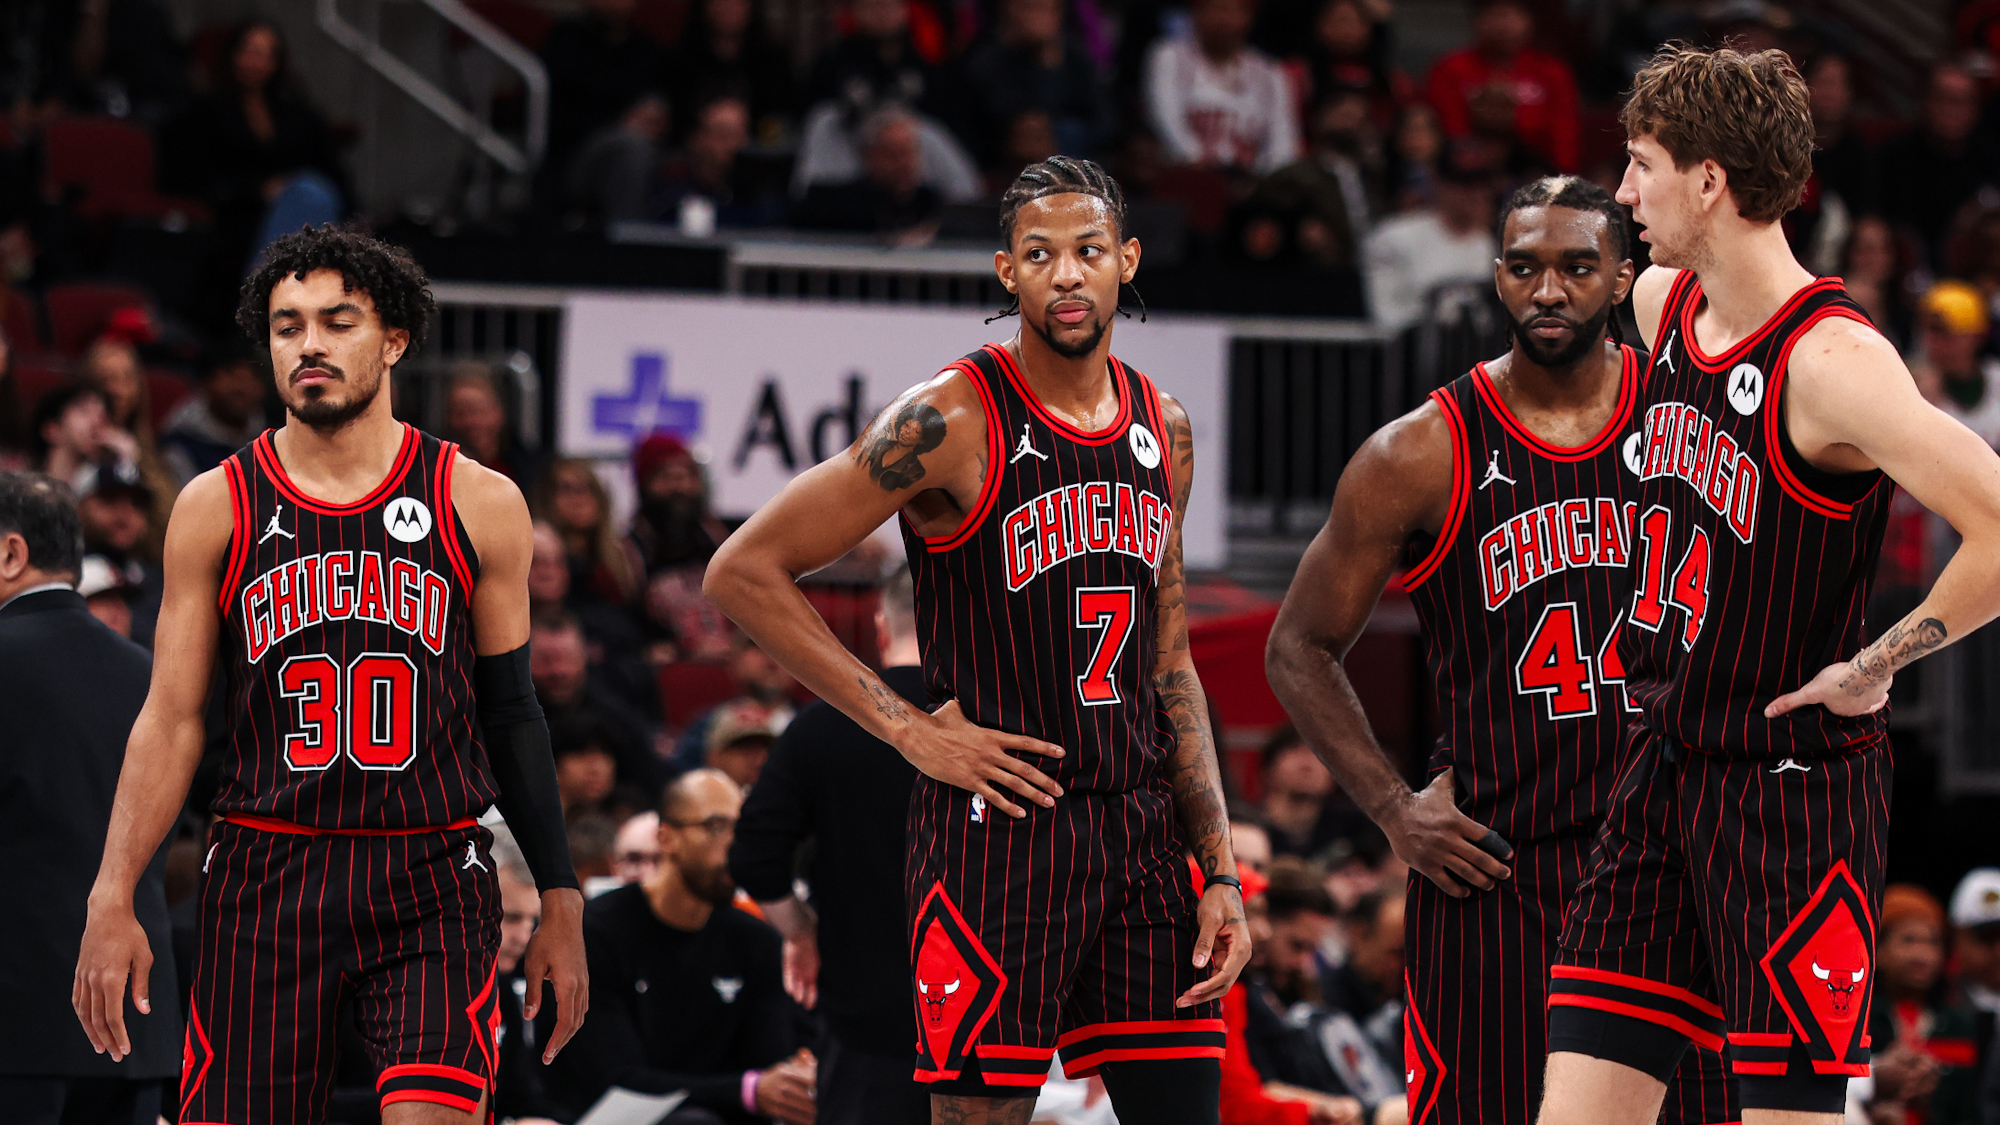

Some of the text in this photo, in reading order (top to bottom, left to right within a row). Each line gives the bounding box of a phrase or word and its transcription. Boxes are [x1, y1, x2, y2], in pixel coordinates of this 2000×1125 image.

[733, 370, 868, 467] Ad
[1002, 481, 1173, 593] CHICAGO
[1478, 497, 1638, 612] CHICA
[1628, 504, 1711, 653] 14
[241, 550, 450, 665] CHICAGO
[1075, 585, 1136, 706] 7
[277, 652, 418, 771] 30
